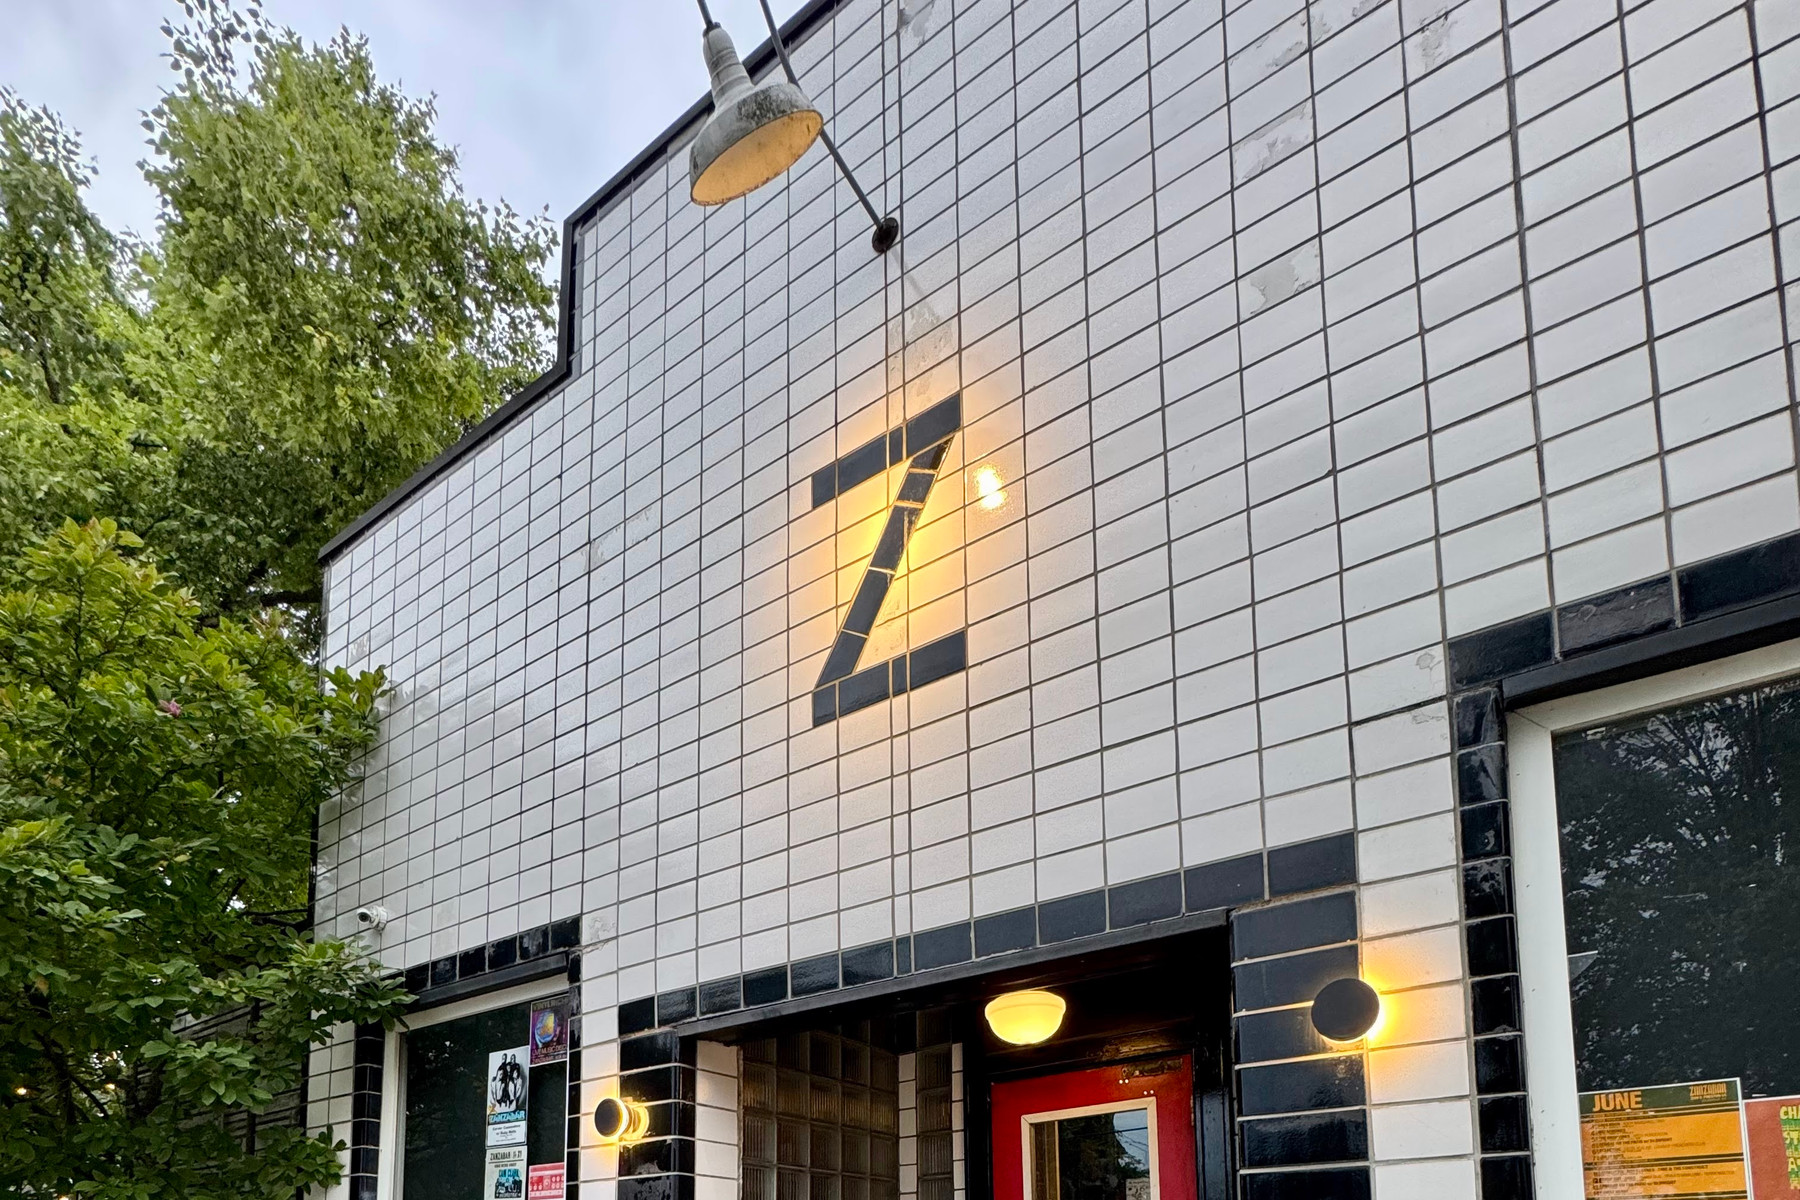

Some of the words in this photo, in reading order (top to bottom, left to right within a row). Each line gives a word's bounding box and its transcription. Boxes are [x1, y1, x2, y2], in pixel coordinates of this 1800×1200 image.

[812, 391, 966, 727] Z
[1592, 1091, 1643, 1112] JUNE
[1780, 1105, 1800, 1120] CH
